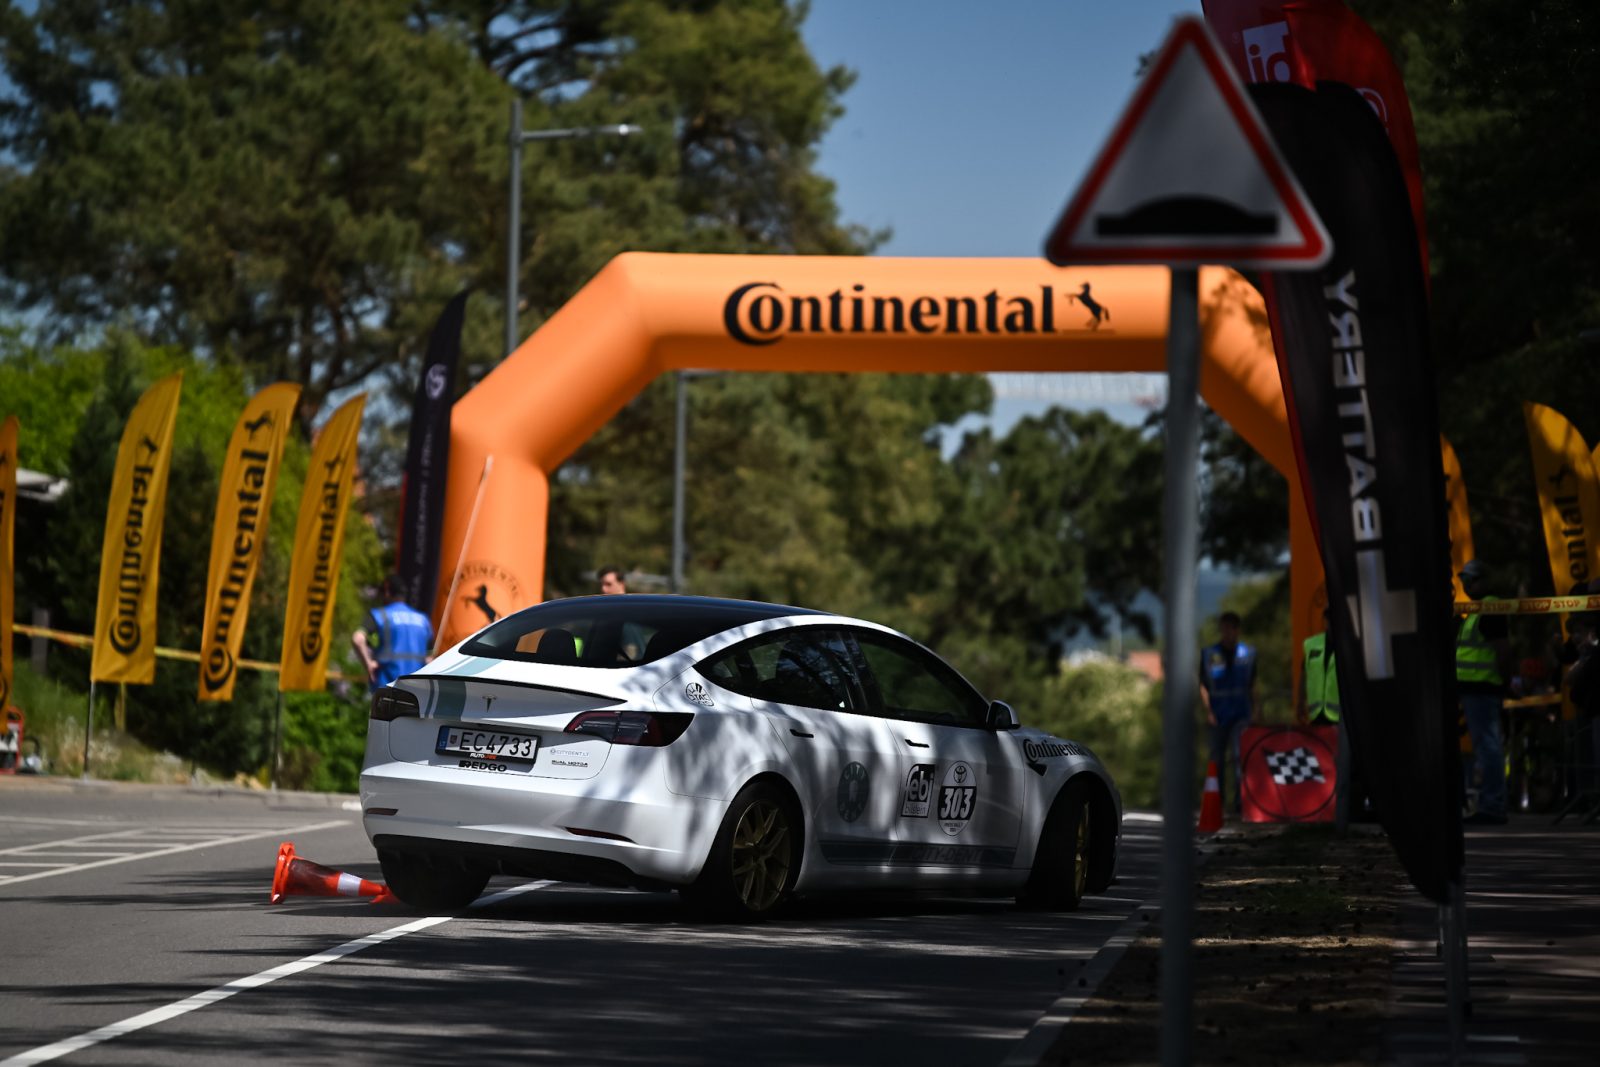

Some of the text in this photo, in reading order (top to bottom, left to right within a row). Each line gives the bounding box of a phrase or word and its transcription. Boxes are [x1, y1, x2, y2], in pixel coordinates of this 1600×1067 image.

[723, 282, 1056, 346] Continental
[1553, 496, 1588, 580] ental
[204, 450, 269, 691] Continental
[300, 480, 338, 663] Continental
[1553, 598, 1580, 608] STOP
[460, 731, 532, 757] EC4733
[906, 765, 935, 801] febi
[940, 787, 974, 819] 303
